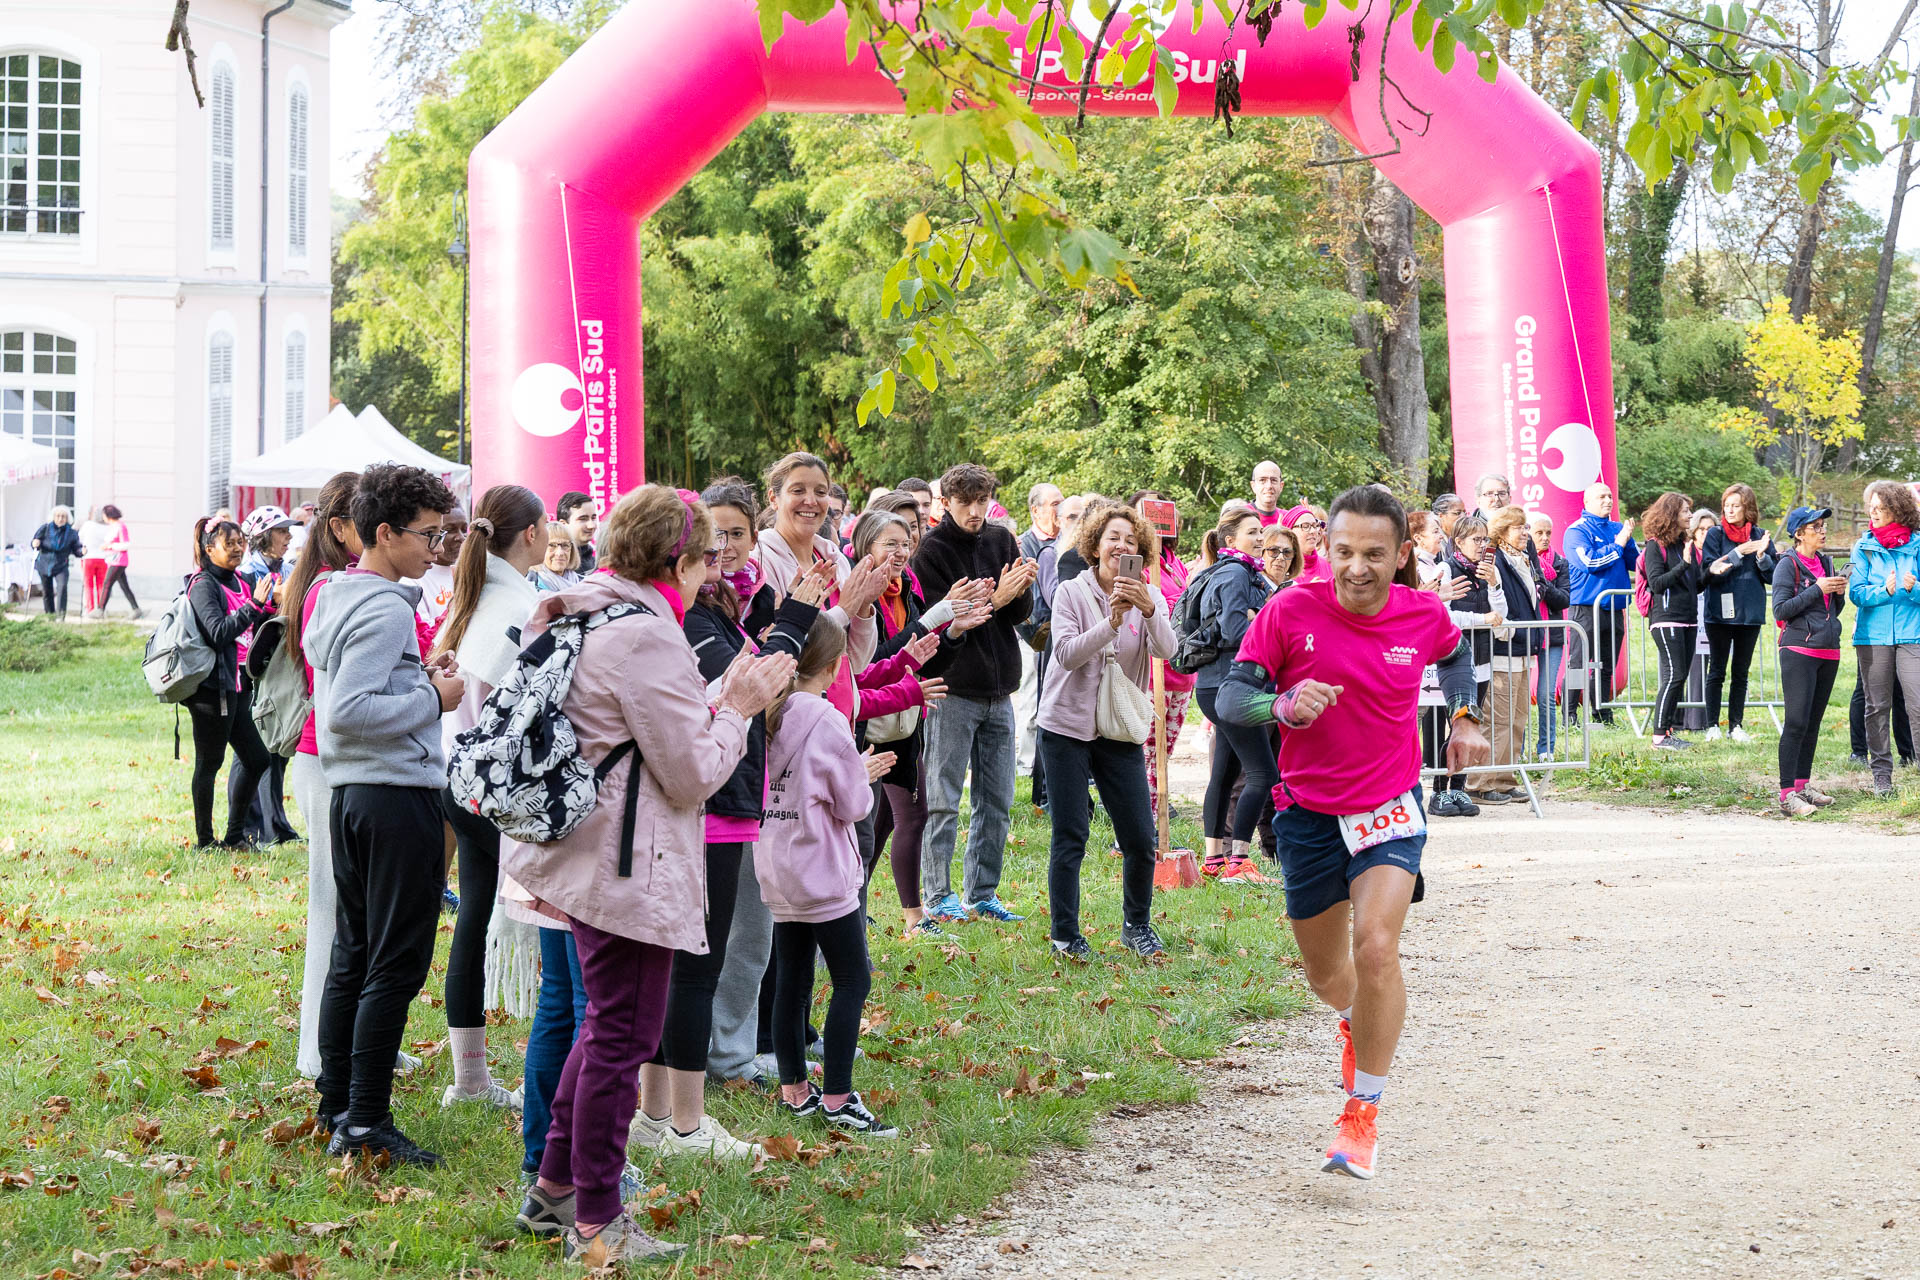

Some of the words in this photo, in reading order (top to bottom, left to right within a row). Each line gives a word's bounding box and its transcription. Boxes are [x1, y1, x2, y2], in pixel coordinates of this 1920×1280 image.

[581, 319, 604, 374] Sud
[1514, 315, 1541, 401] Grand
[583, 380, 605, 454] Paris
[608, 368, 618, 502] Seine-Essonne-Sénart
[1519, 407, 1541, 479] Paris
[583, 461, 606, 516] and
[1423, 669, 1438, 679] ISIT
[766, 809, 799, 820] pagnie
[773, 795, 780, 804] &
[1354, 805, 1411, 841] 108
